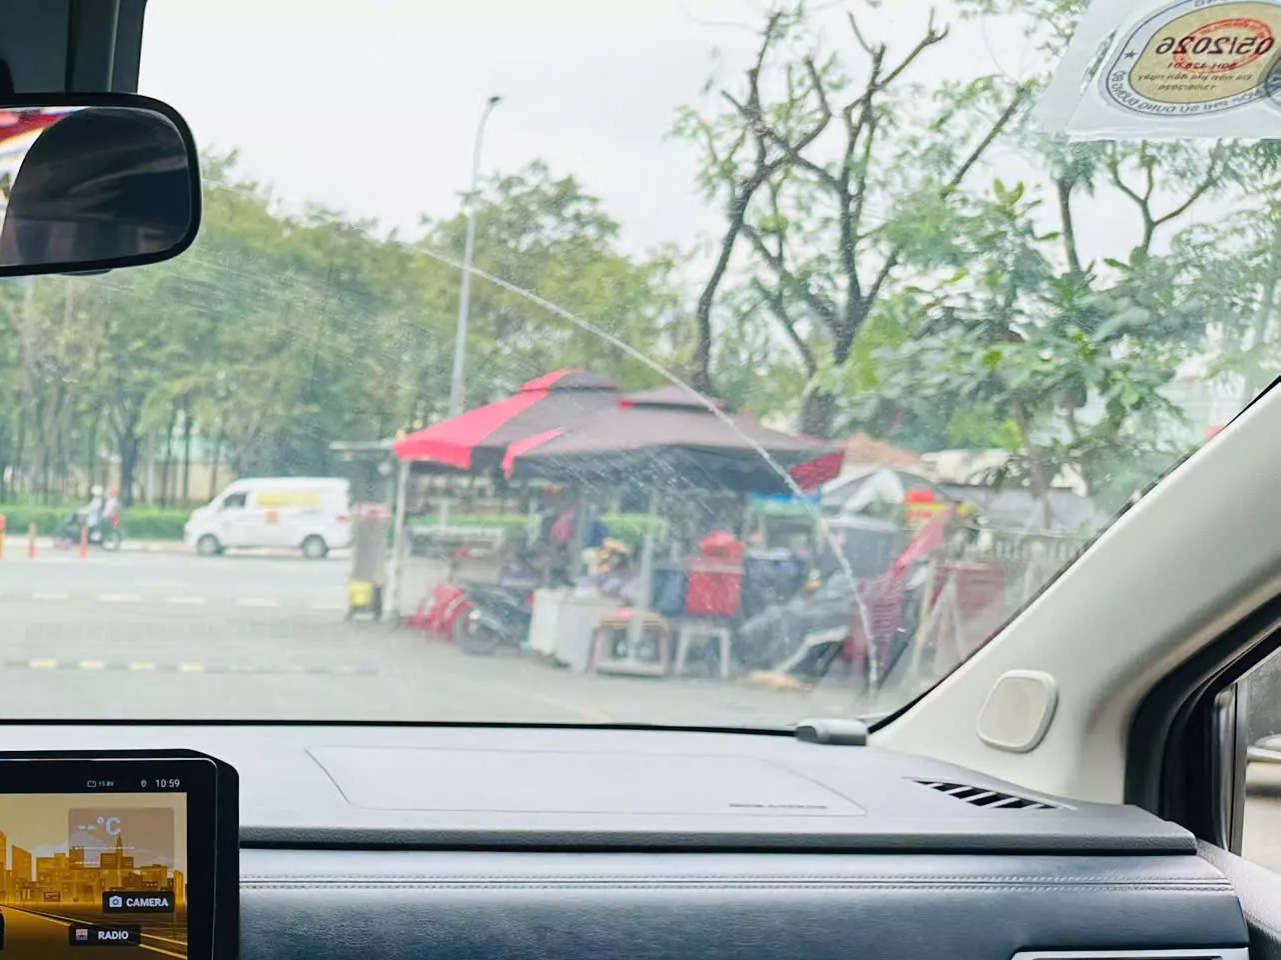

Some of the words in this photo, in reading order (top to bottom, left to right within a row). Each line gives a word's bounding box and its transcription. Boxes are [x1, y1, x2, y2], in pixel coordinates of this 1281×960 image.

[156, 779, 180, 788] 10:59
[126, 898, 169, 907] CAMERA
[98, 930, 129, 940] RADIO
